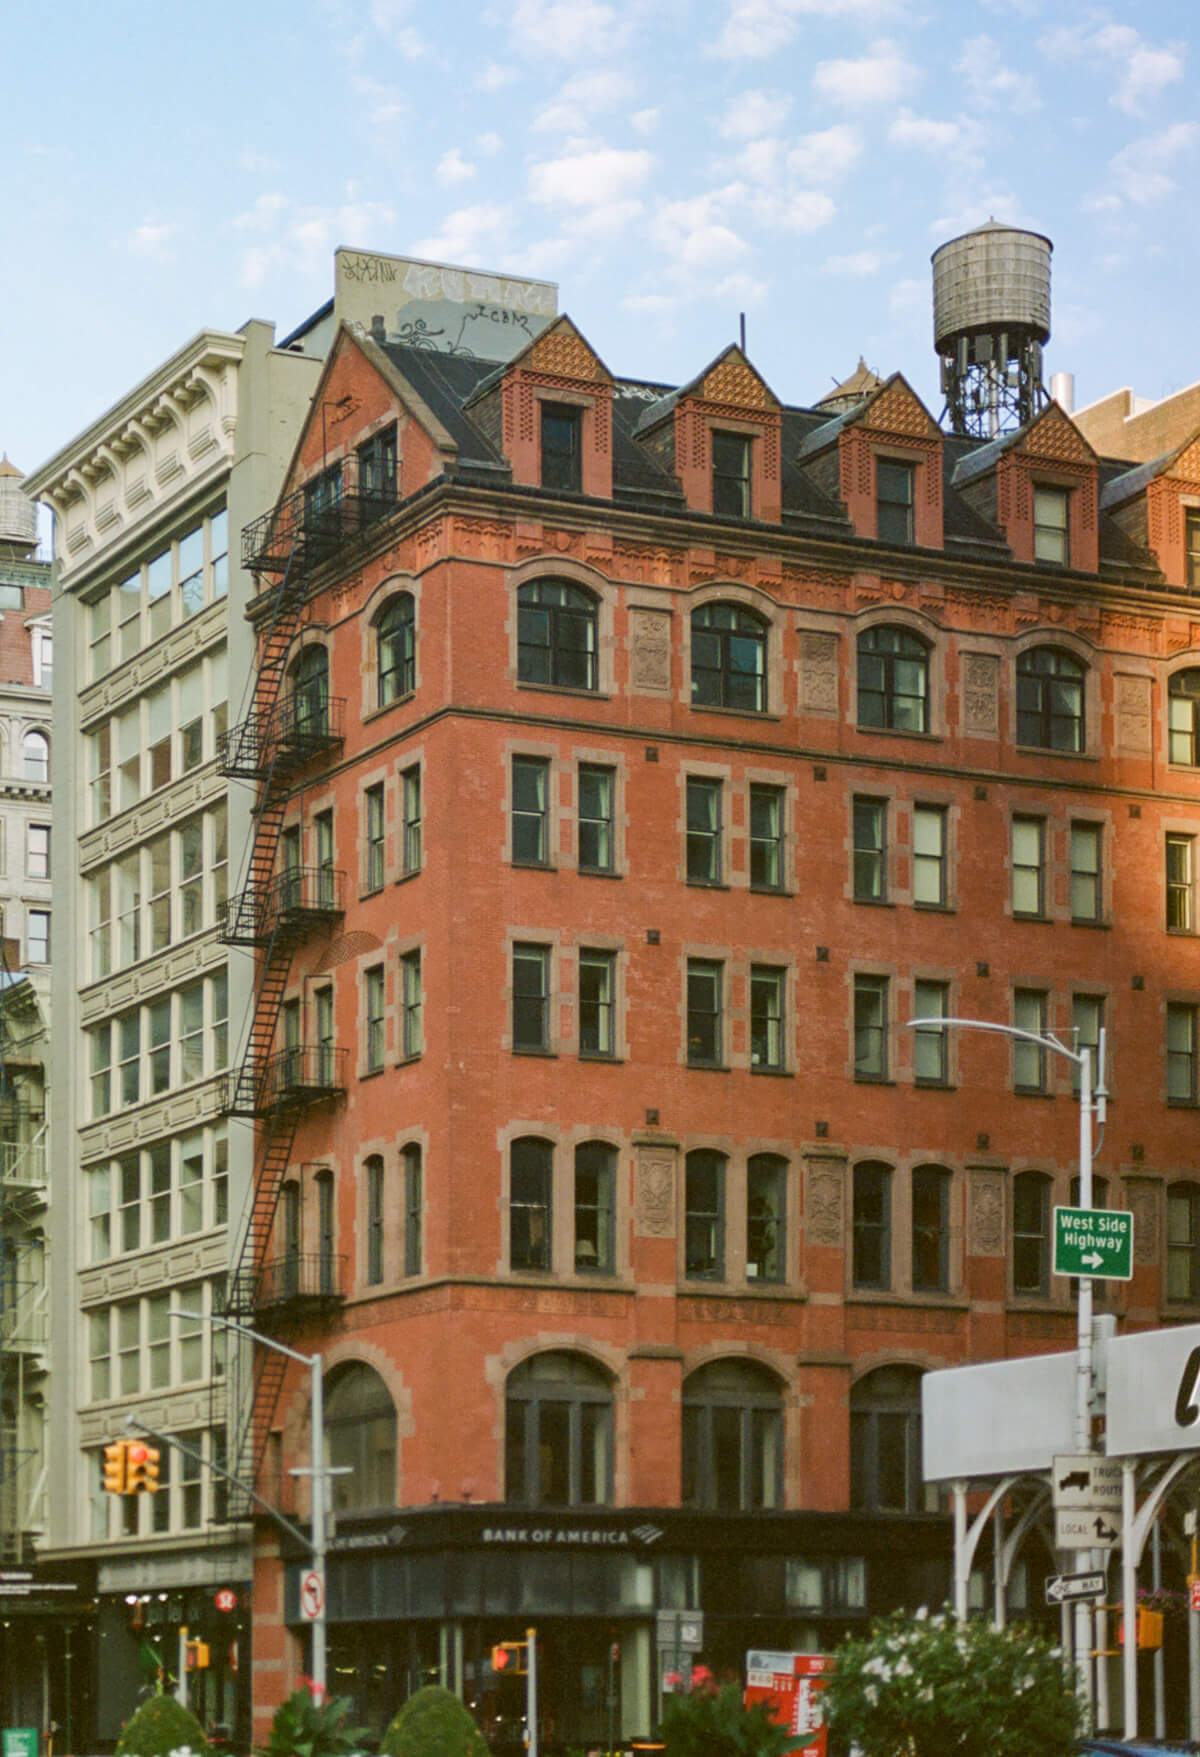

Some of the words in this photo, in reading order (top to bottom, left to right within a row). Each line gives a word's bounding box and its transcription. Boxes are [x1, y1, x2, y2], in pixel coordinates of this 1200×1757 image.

[1061, 1214, 1093, 1230] West
[1098, 1216, 1127, 1233] Side
[1064, 1232, 1123, 1253] Highway
[1093, 1467, 1122, 1478] TRUC
[483, 1528, 527, 1543] BANK
[531, 1529, 553, 1543] OF
[556, 1530, 629, 1543] AMERICA
[1061, 1524, 1088, 1536] LOCAL
[1054, 1584, 1072, 1594] ONE
[1082, 1579, 1101, 1591] WAY
